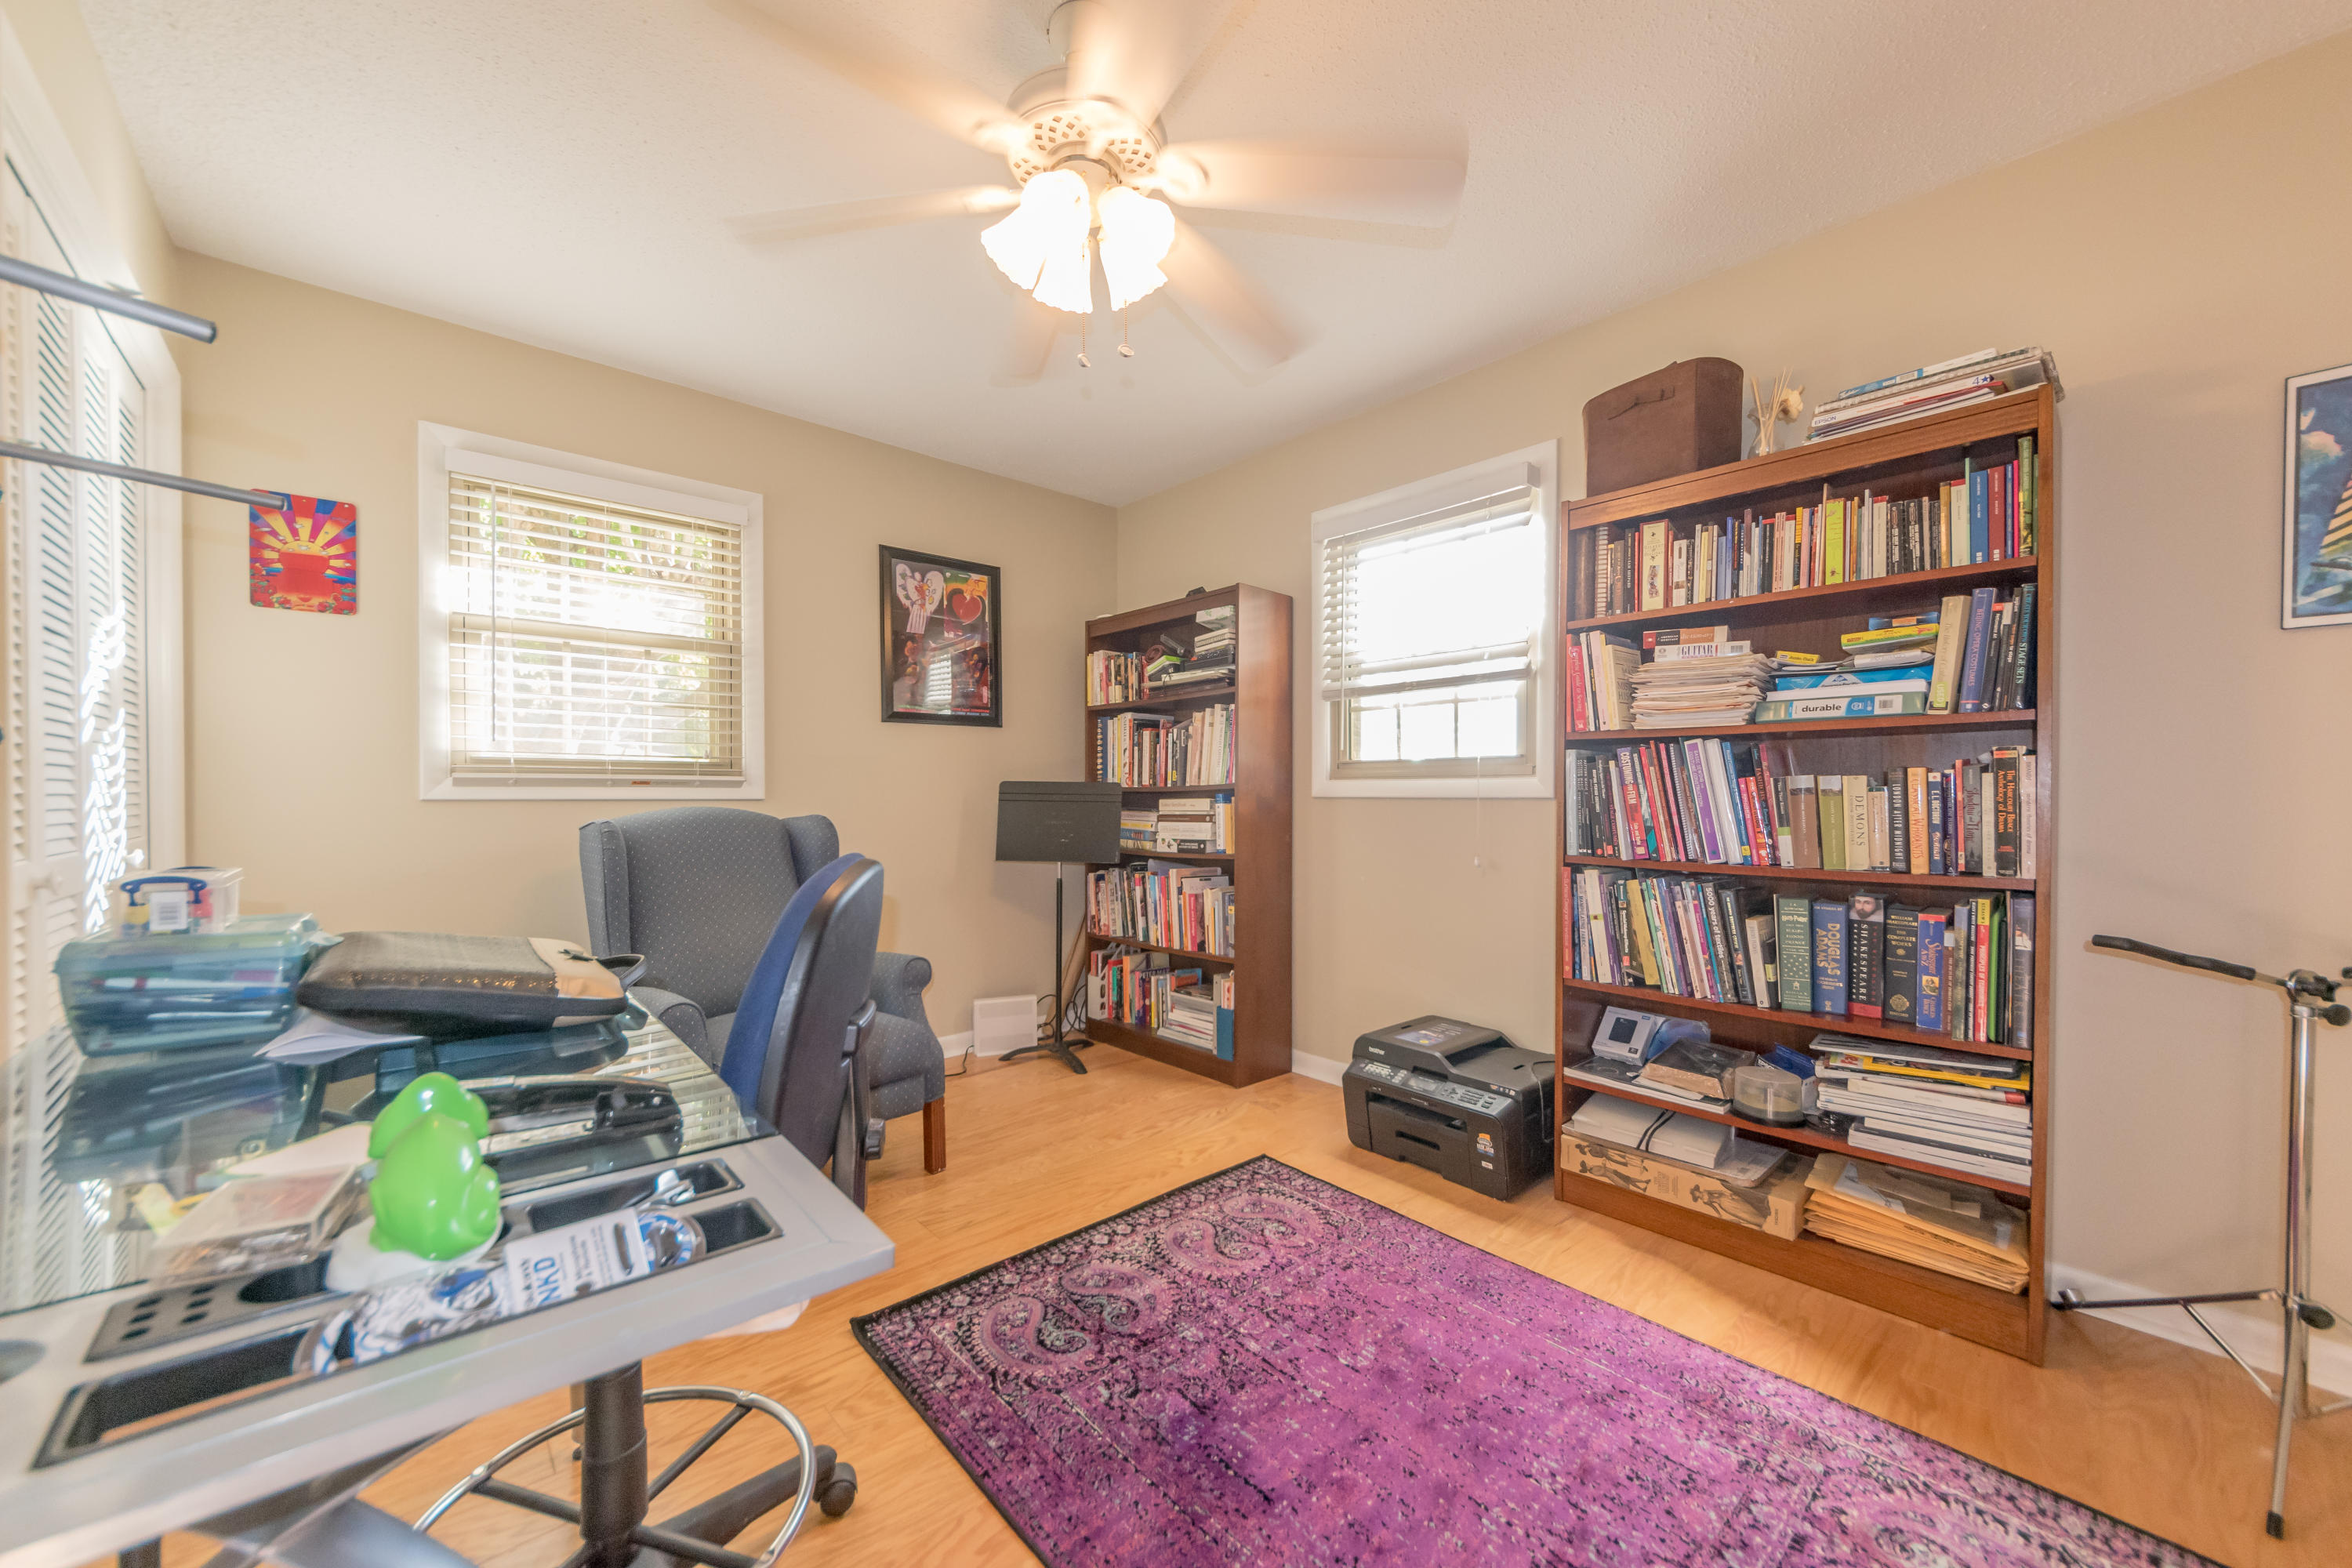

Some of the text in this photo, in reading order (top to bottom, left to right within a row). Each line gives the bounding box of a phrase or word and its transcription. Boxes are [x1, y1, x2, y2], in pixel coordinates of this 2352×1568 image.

[1815, 416, 1836, 425] EPSON
[1682, 644, 1713, 655] GUITAR
[1968, 608, 1984, 686] BEIJING OPERA COSTUMES
[2017, 642, 2027, 666] STAGE
[2016, 666, 2025, 684] SETS
[1621, 752, 1634, 784] COSTUMING
[1627, 791, 1637, 804] FILM
[1855, 796, 1865, 847] DEMONS
[1892, 784, 1904, 859] LONDON AFTER MIDNIGHT
[1911, 779, 1924, 858] CLASSICAL WHODUNITS
[1706, 887, 1715, 906] 5000
[1709, 907, 1719, 925] years
[1715, 935, 1724, 958] textiles
[1816, 928, 1828, 967] ADAMS
[1828, 923, 1840, 975] DOUGLAS
[1859, 924, 1867, 1001] SHAKESPEARE
[2015, 958, 2024, 1016] THEATRE
[1368, 1046, 1385, 1055] brother
[533, 1257, 562, 1306] NKD
